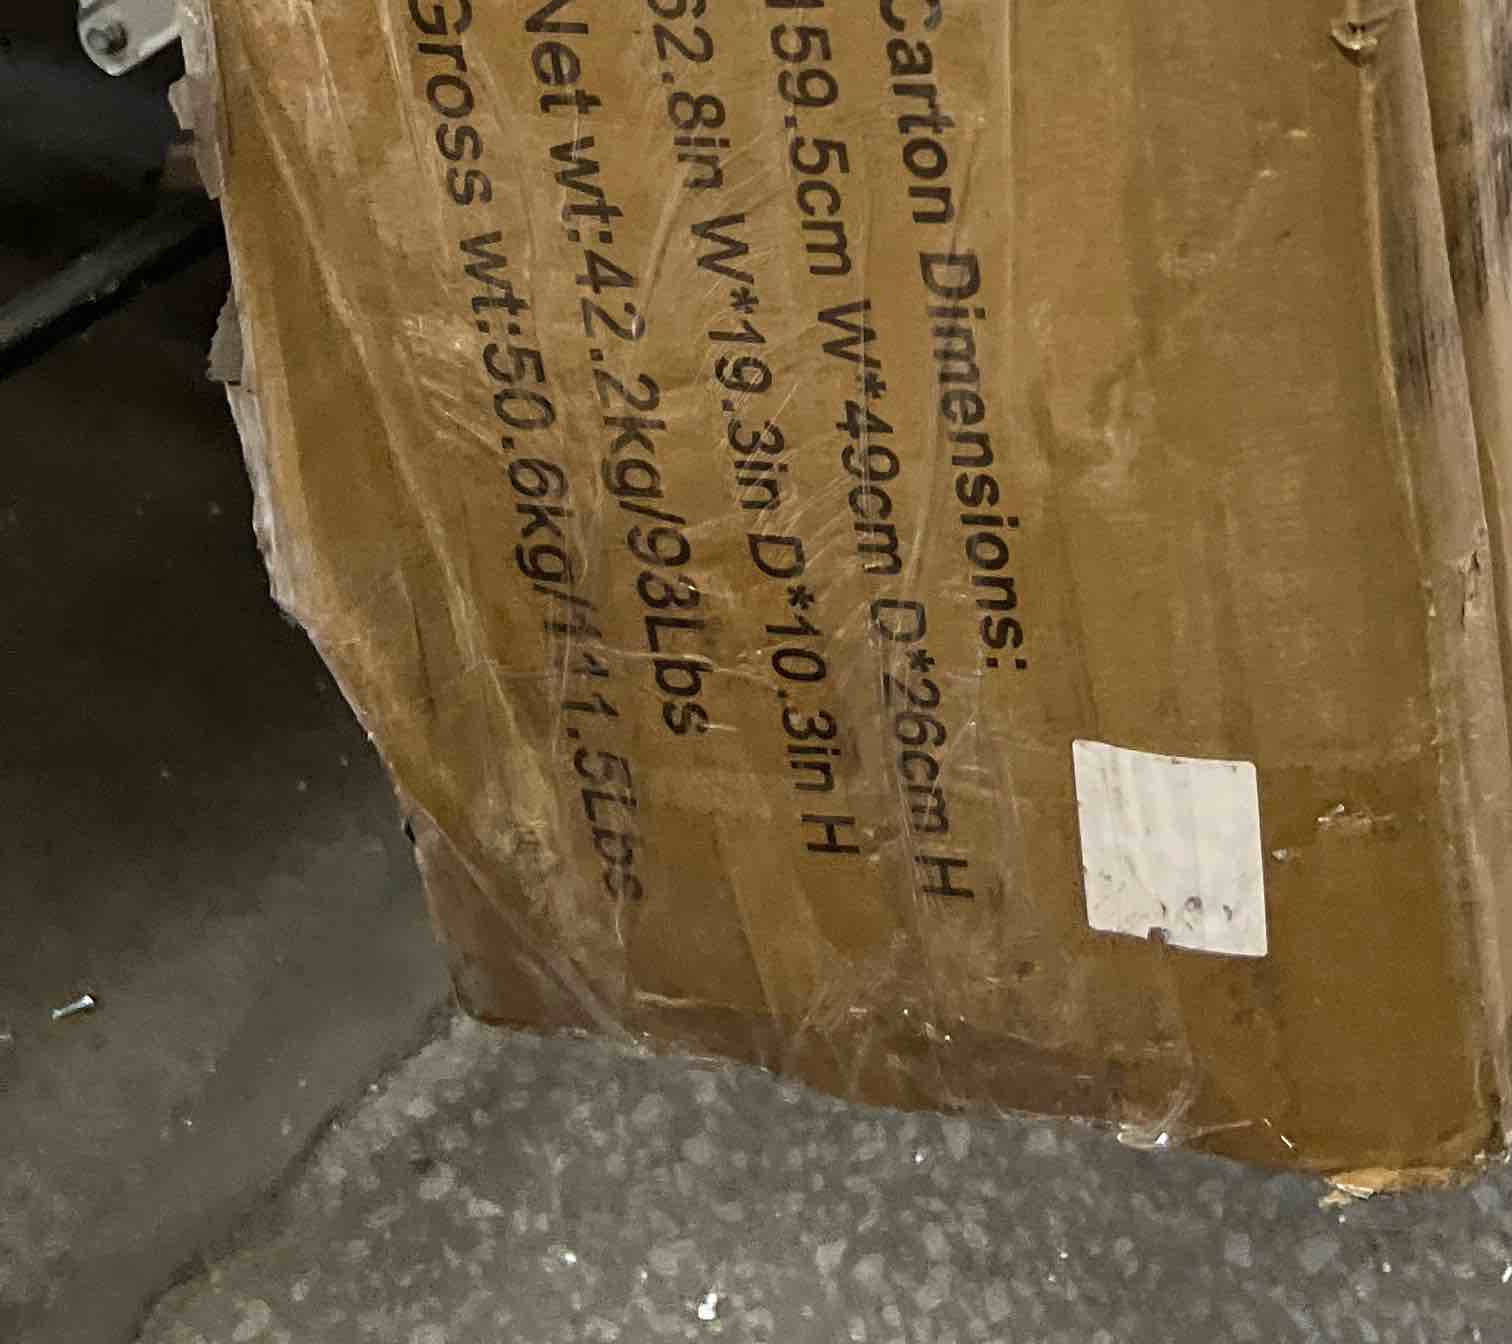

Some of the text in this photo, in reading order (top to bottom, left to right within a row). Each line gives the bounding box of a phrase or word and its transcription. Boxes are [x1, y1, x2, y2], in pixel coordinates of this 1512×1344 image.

[556, 135, 716, 738] wt:42.2kg/93Lbs
[918, 252, 1028, 672] Dimensions:
[801, 813, 859, 857] H
[917, 854, 974, 902] H
